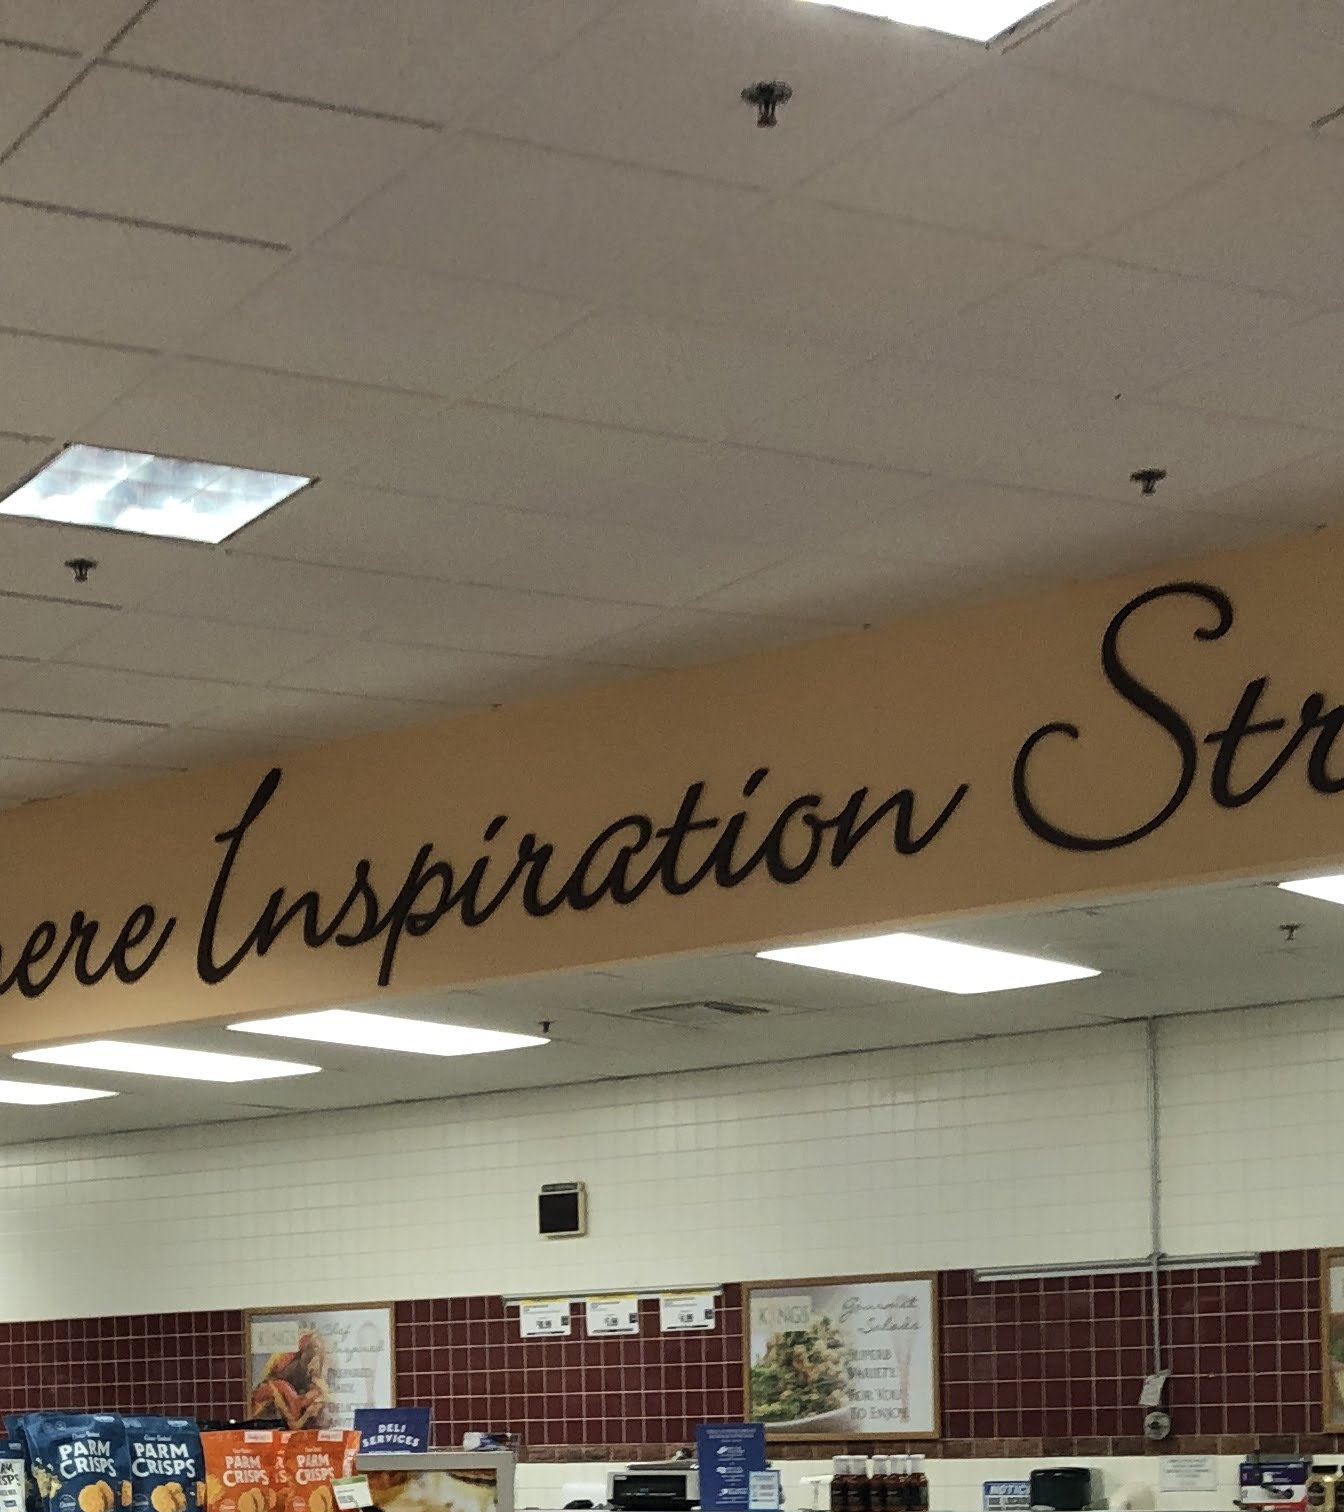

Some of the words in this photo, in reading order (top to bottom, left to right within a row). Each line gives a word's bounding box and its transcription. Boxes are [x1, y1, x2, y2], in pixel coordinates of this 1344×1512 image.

[196, 767, 972, 987] Inspiration
[378, 1424, 406, 1434] DELI
[58, 1439, 111, 1460] PARM
[362, 1434, 420, 1449] SERVICES
[133, 1442, 189, 1459] PARM
[60, 1457, 116, 1479] CRISPS
[132, 1459, 195, 1478] CRISPS
[225, 1455, 262, 1469] PARM
[297, 1454, 330, 1468] PARM
[223, 1470, 269, 1487] CRISPS
[296, 1467, 334, 1485] CRISPS
[989, 1484, 1030, 1495] NOTIC
